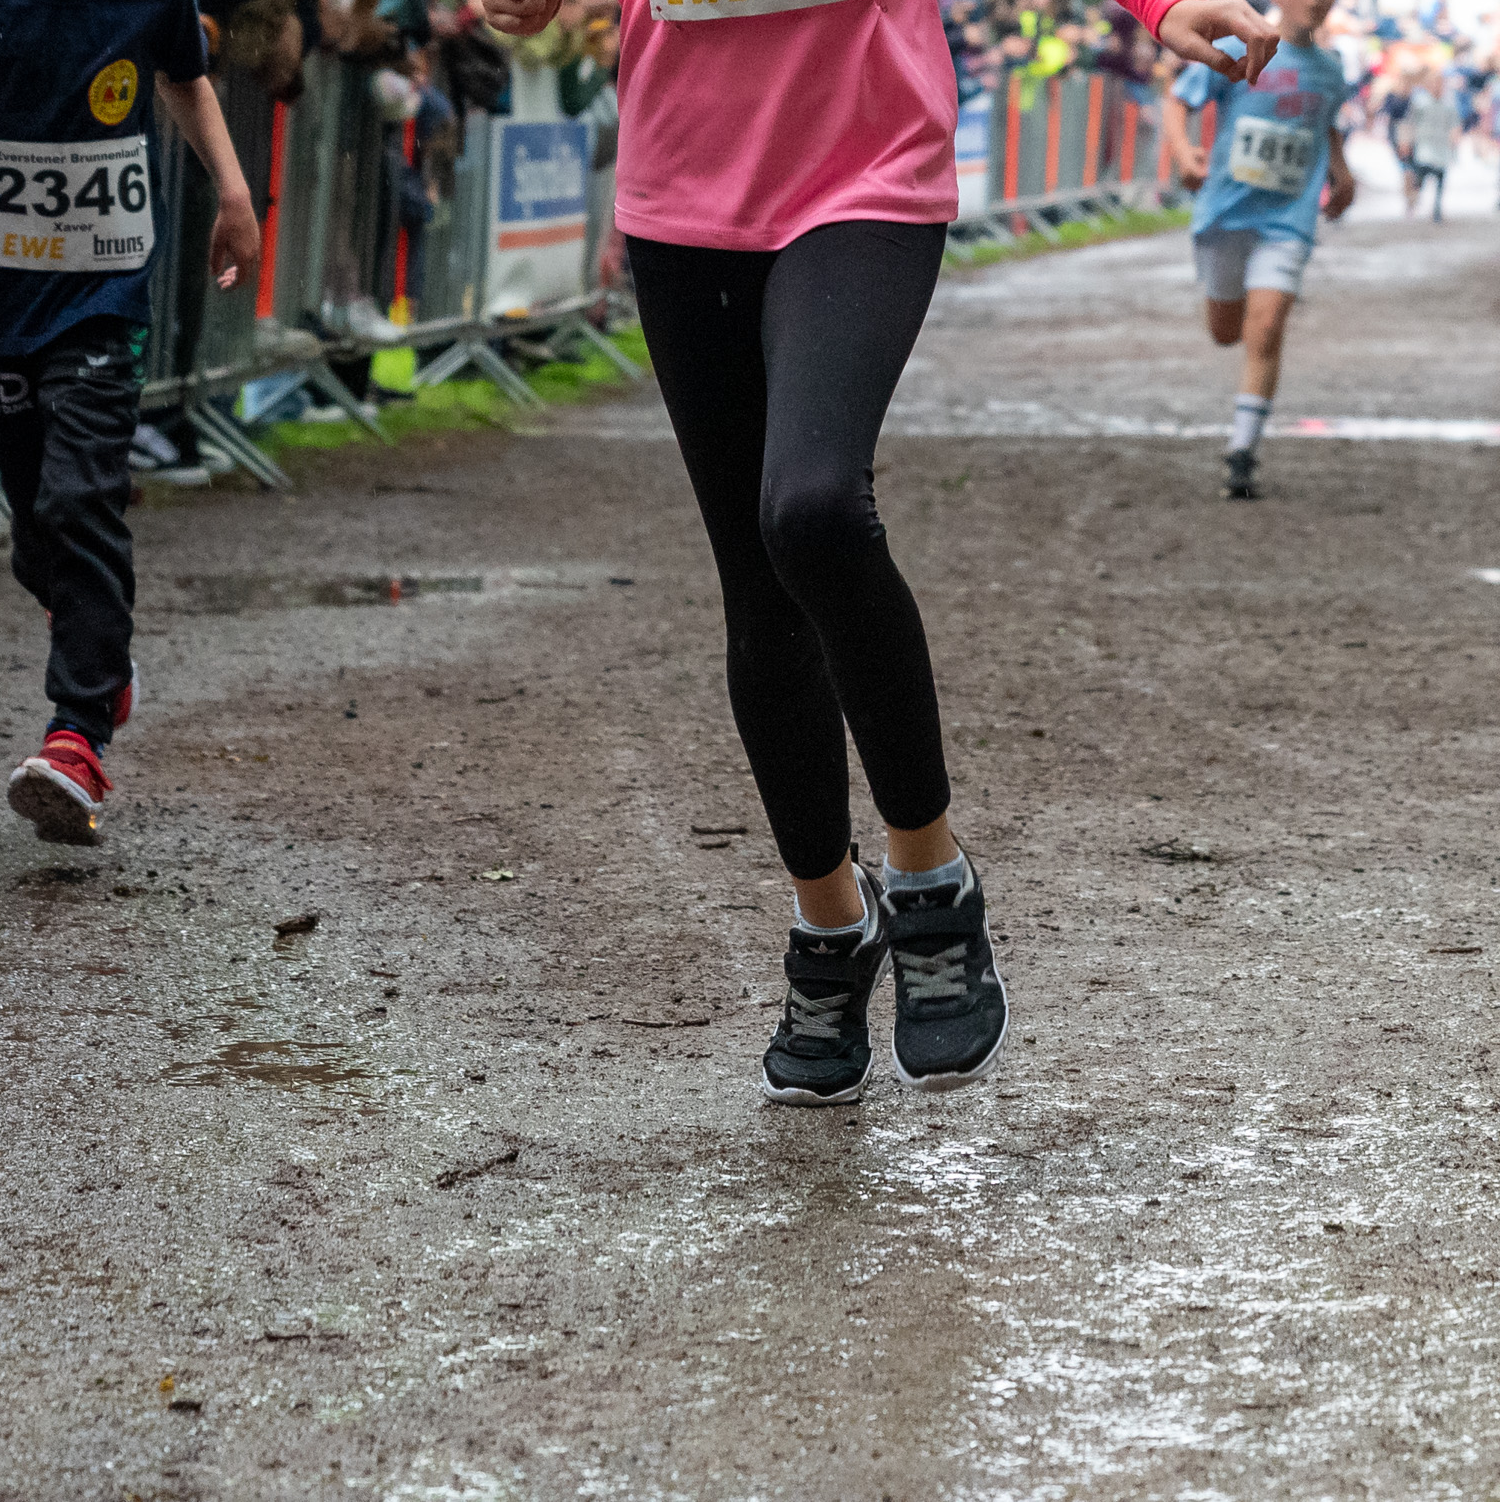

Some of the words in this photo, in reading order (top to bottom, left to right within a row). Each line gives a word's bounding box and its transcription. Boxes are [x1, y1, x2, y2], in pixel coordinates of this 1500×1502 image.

[70, 148, 140, 164] Brunnenlauf
[52, 221, 95, 233] Xaver
[2, 232, 67, 260] EWE
[93, 234, 145, 256] bruns
